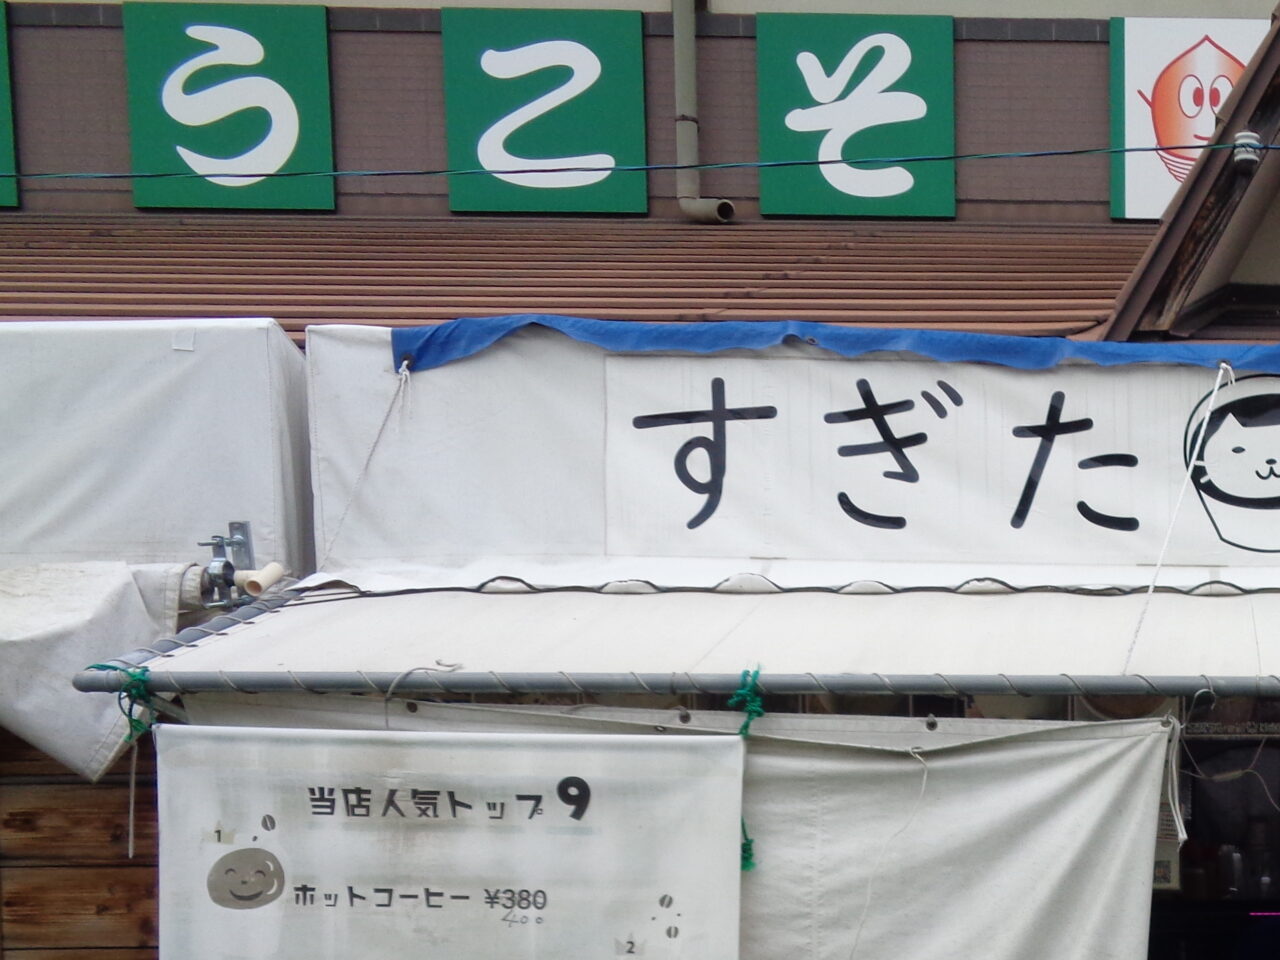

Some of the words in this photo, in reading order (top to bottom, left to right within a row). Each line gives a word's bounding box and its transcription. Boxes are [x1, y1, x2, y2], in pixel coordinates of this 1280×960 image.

[632, 377, 1139, 529] すぎた
[307, 776, 592, 821] 当店人気トップ9
[214, 829, 222, 843] 1
[293, 885, 470, 908] ホットコーヒー
[483, 888, 547, 911] ¥380
[625, 941, 635, 954] 2
